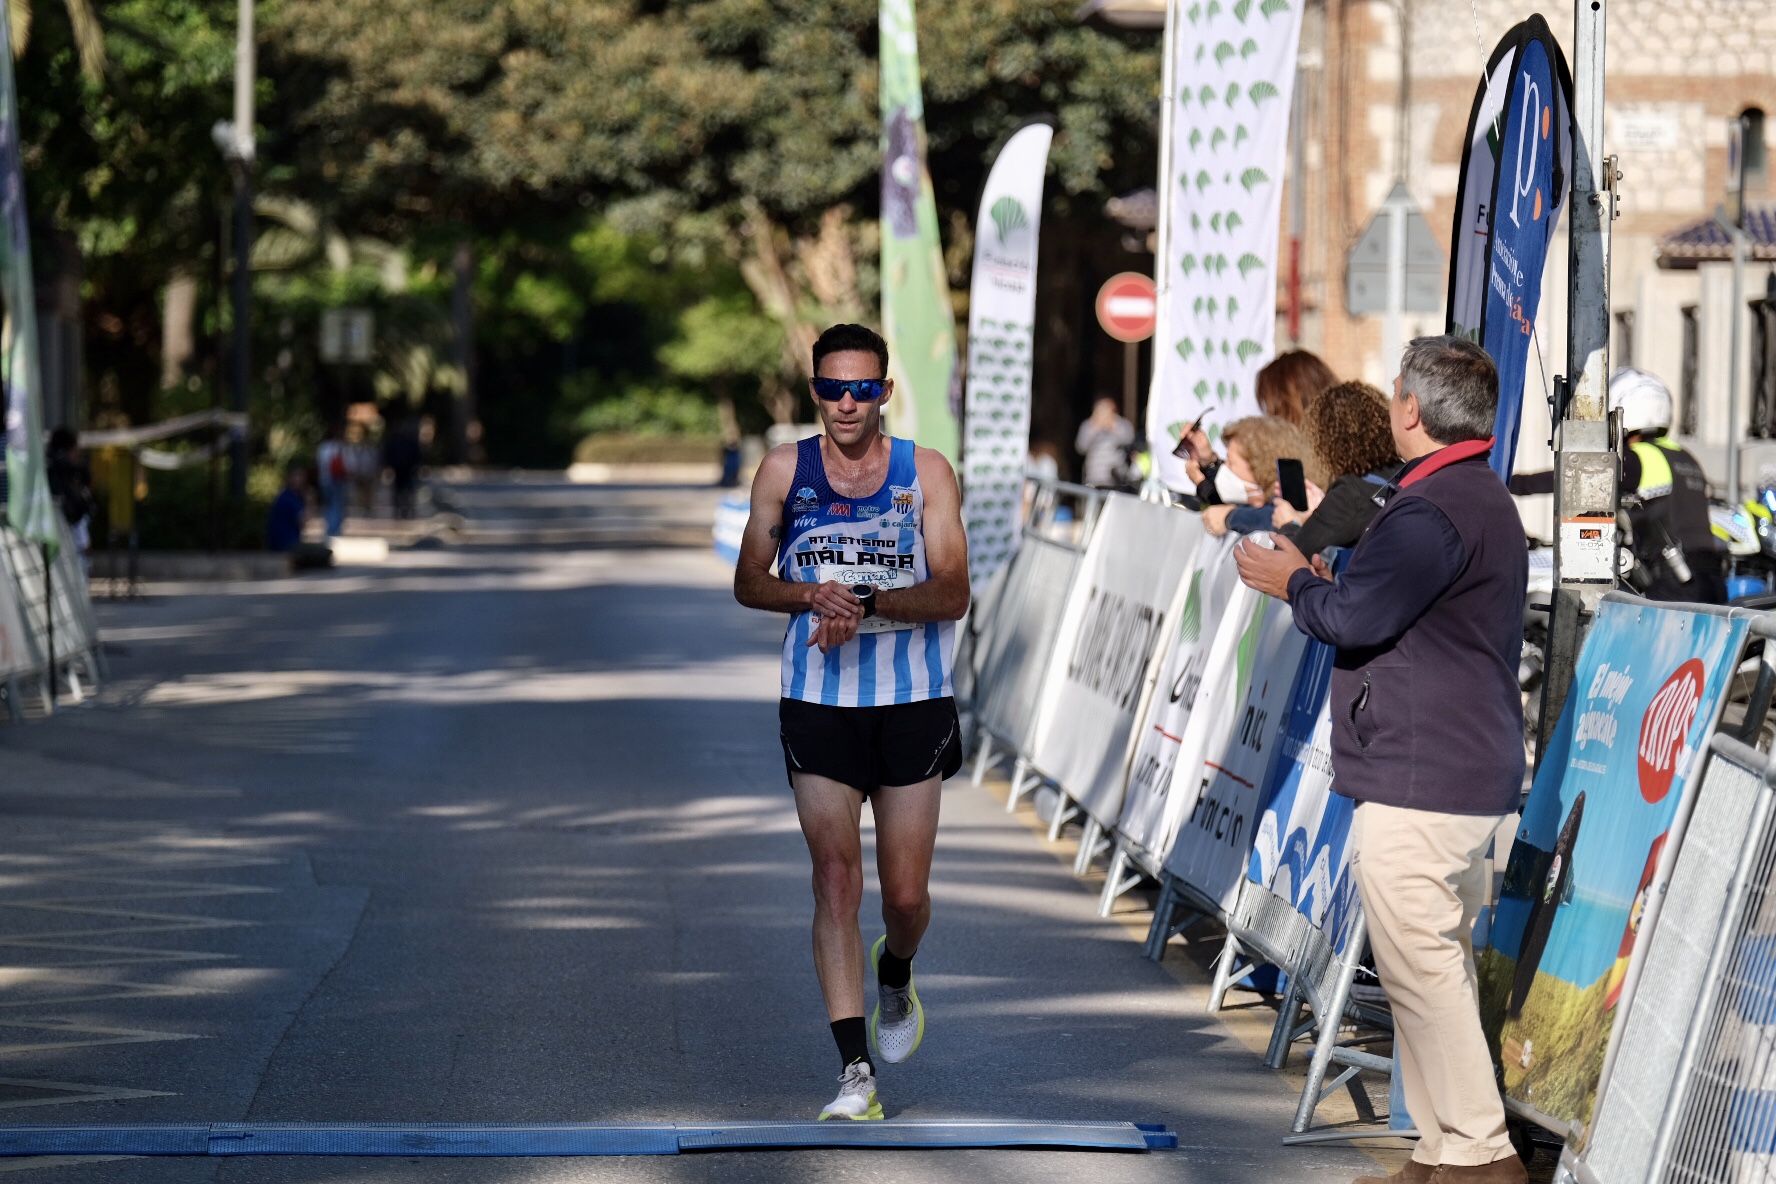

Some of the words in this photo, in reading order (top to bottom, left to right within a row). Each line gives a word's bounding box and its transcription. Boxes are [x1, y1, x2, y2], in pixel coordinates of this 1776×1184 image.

[808, 536, 895, 547] ATLETISMO
[795, 547, 915, 569] MÁLAGA
[1639, 670, 1699, 773] TROPS
